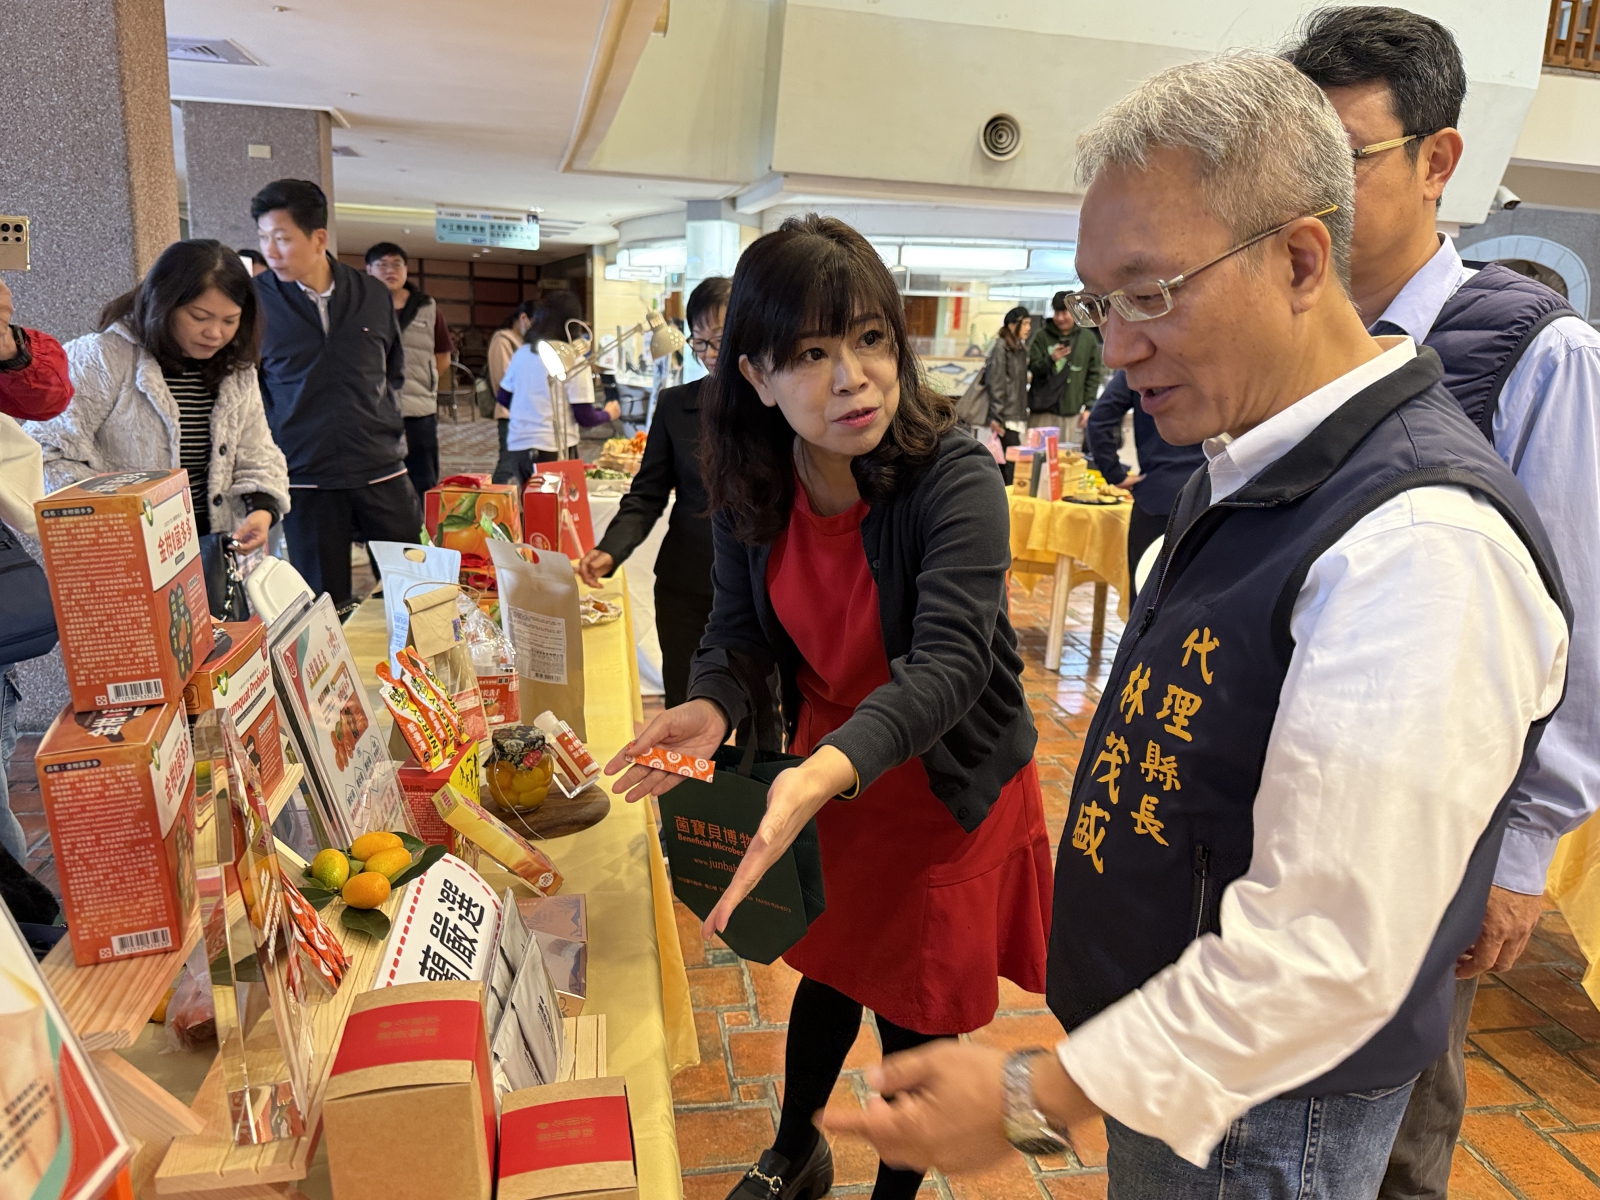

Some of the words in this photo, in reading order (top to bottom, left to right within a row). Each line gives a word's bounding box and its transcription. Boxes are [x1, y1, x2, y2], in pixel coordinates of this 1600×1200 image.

[226, 686, 251, 717] umquat
[410, 709, 440, 757] ENERGY
[1130, 627, 1220, 847] 代理縣長
[1072, 662, 1151, 874] 林茂盛
[677, 833, 712, 848] Beneficial
[712, 841, 745, 857] Microbes
